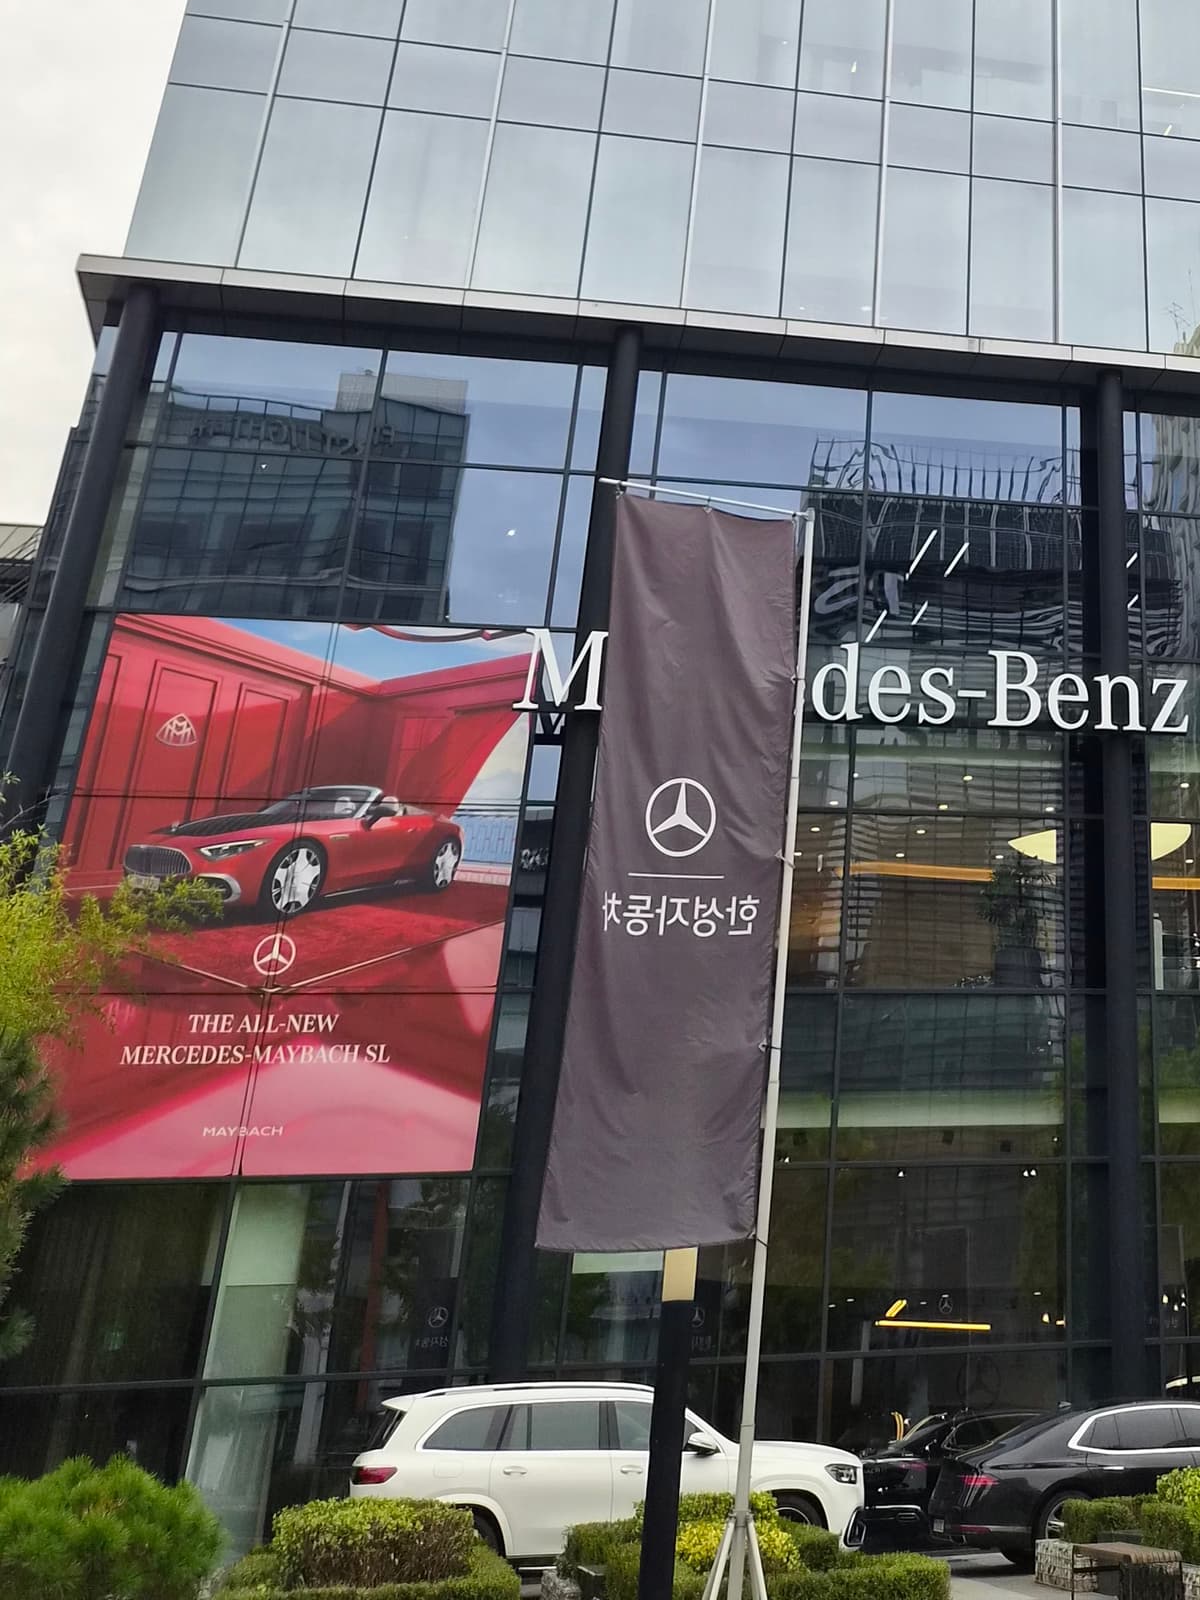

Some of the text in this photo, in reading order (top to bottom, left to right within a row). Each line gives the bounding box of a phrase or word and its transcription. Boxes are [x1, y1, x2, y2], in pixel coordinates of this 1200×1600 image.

[512, 627, 1190, 734] Mdes-Benz
[188, 1014, 340, 1033] THE ALL-NEW
[120, 1043, 391, 1065] MERCEDES-MAYBACH SL
[202, 1125, 284, 1137] MAYBACH
